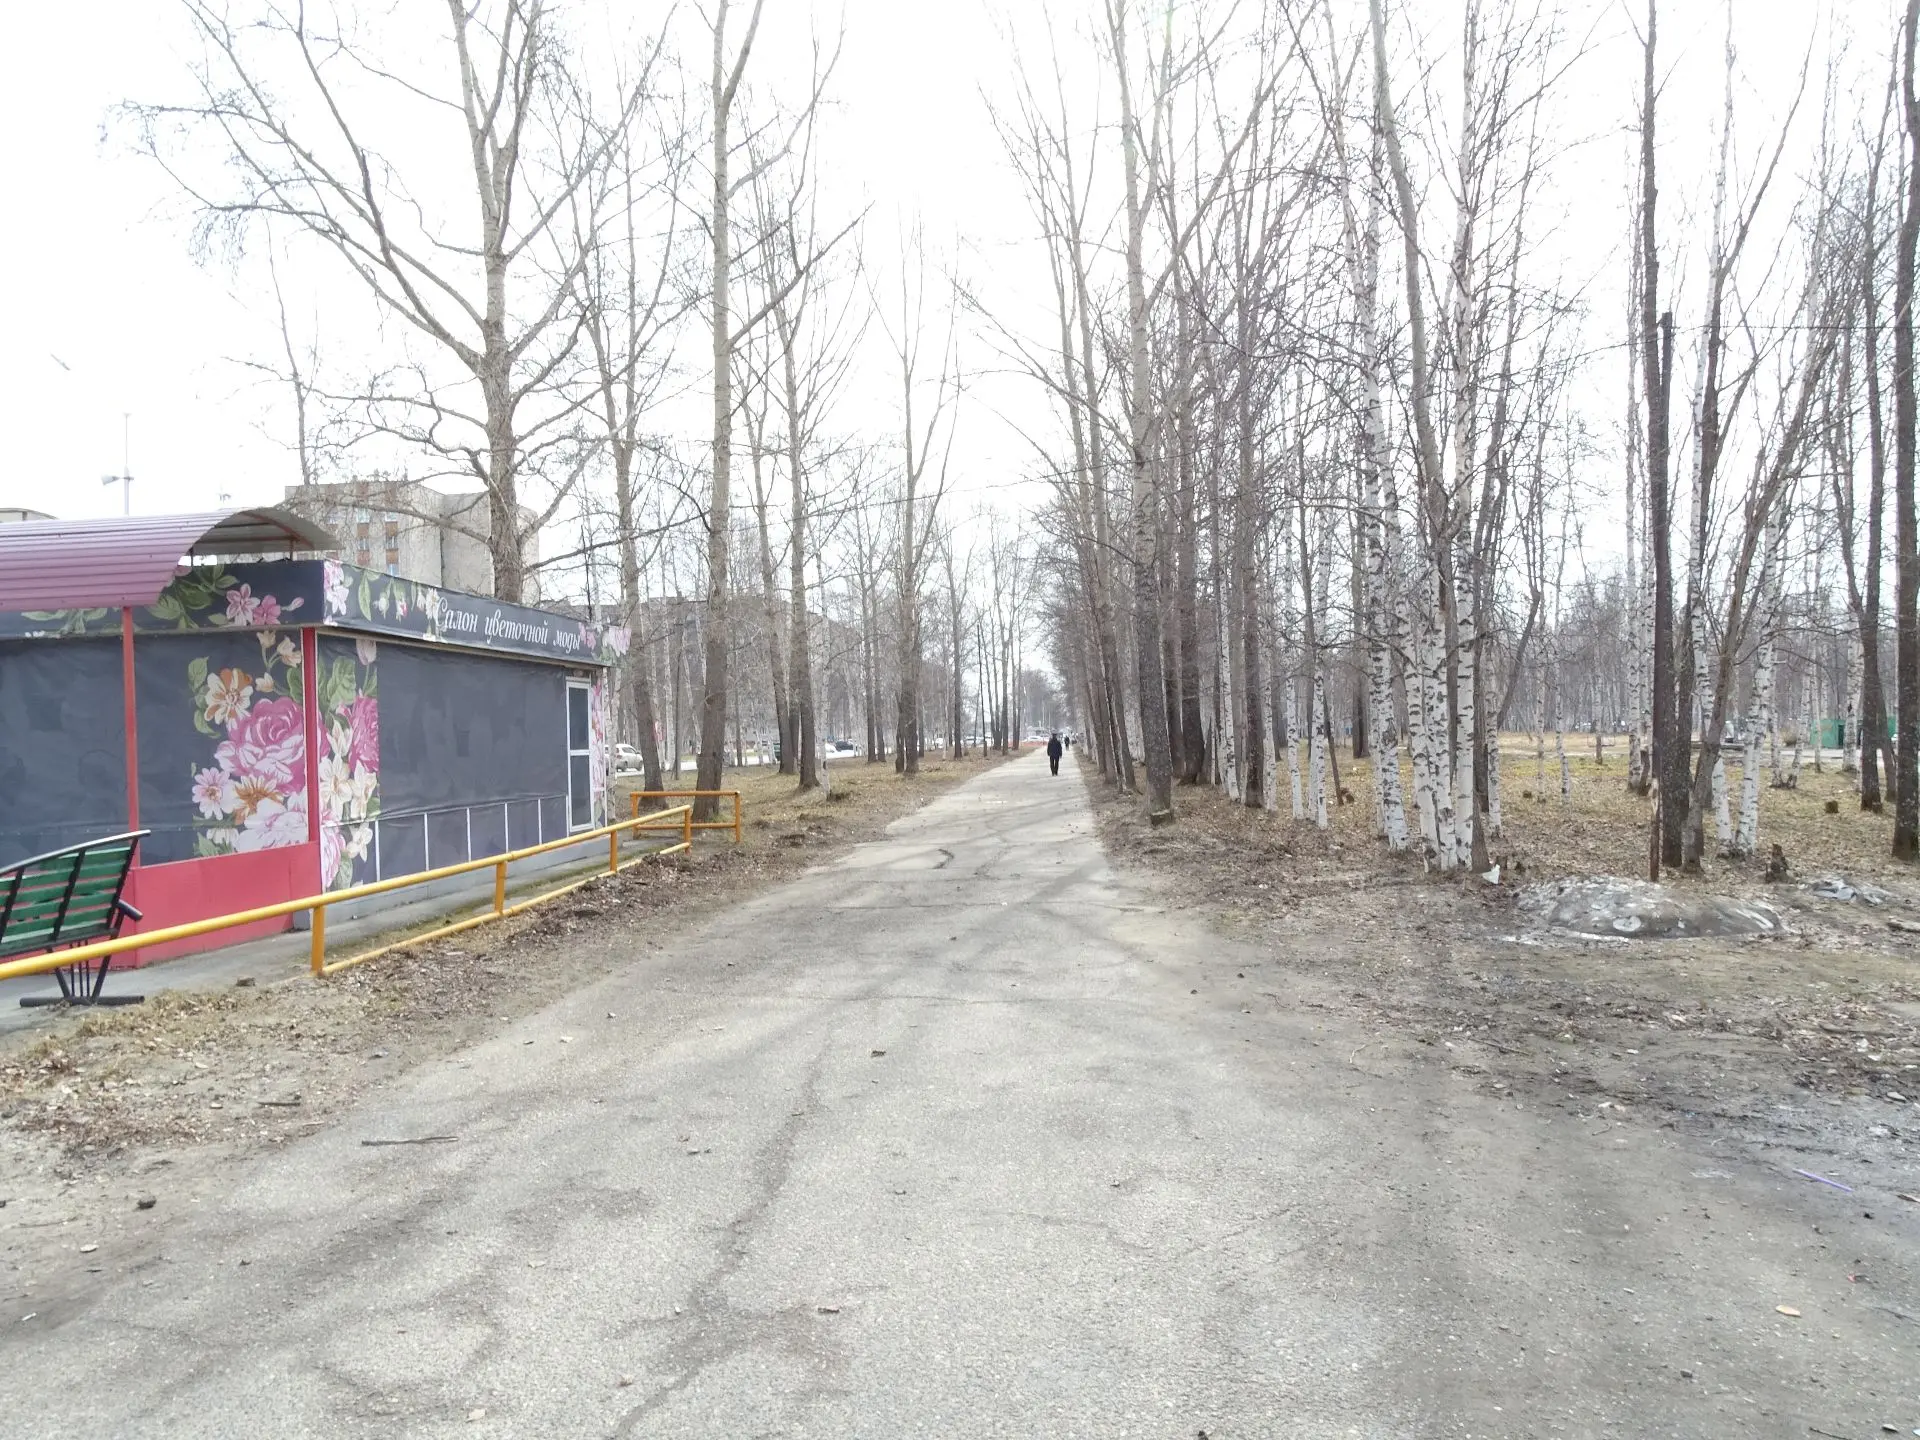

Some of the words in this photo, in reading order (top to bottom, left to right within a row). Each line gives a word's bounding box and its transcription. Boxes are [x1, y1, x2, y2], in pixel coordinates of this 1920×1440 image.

[435, 597, 478, 633] Салон
[484, 608, 549, 645] цветочной
[552, 628, 581, 654] моды
